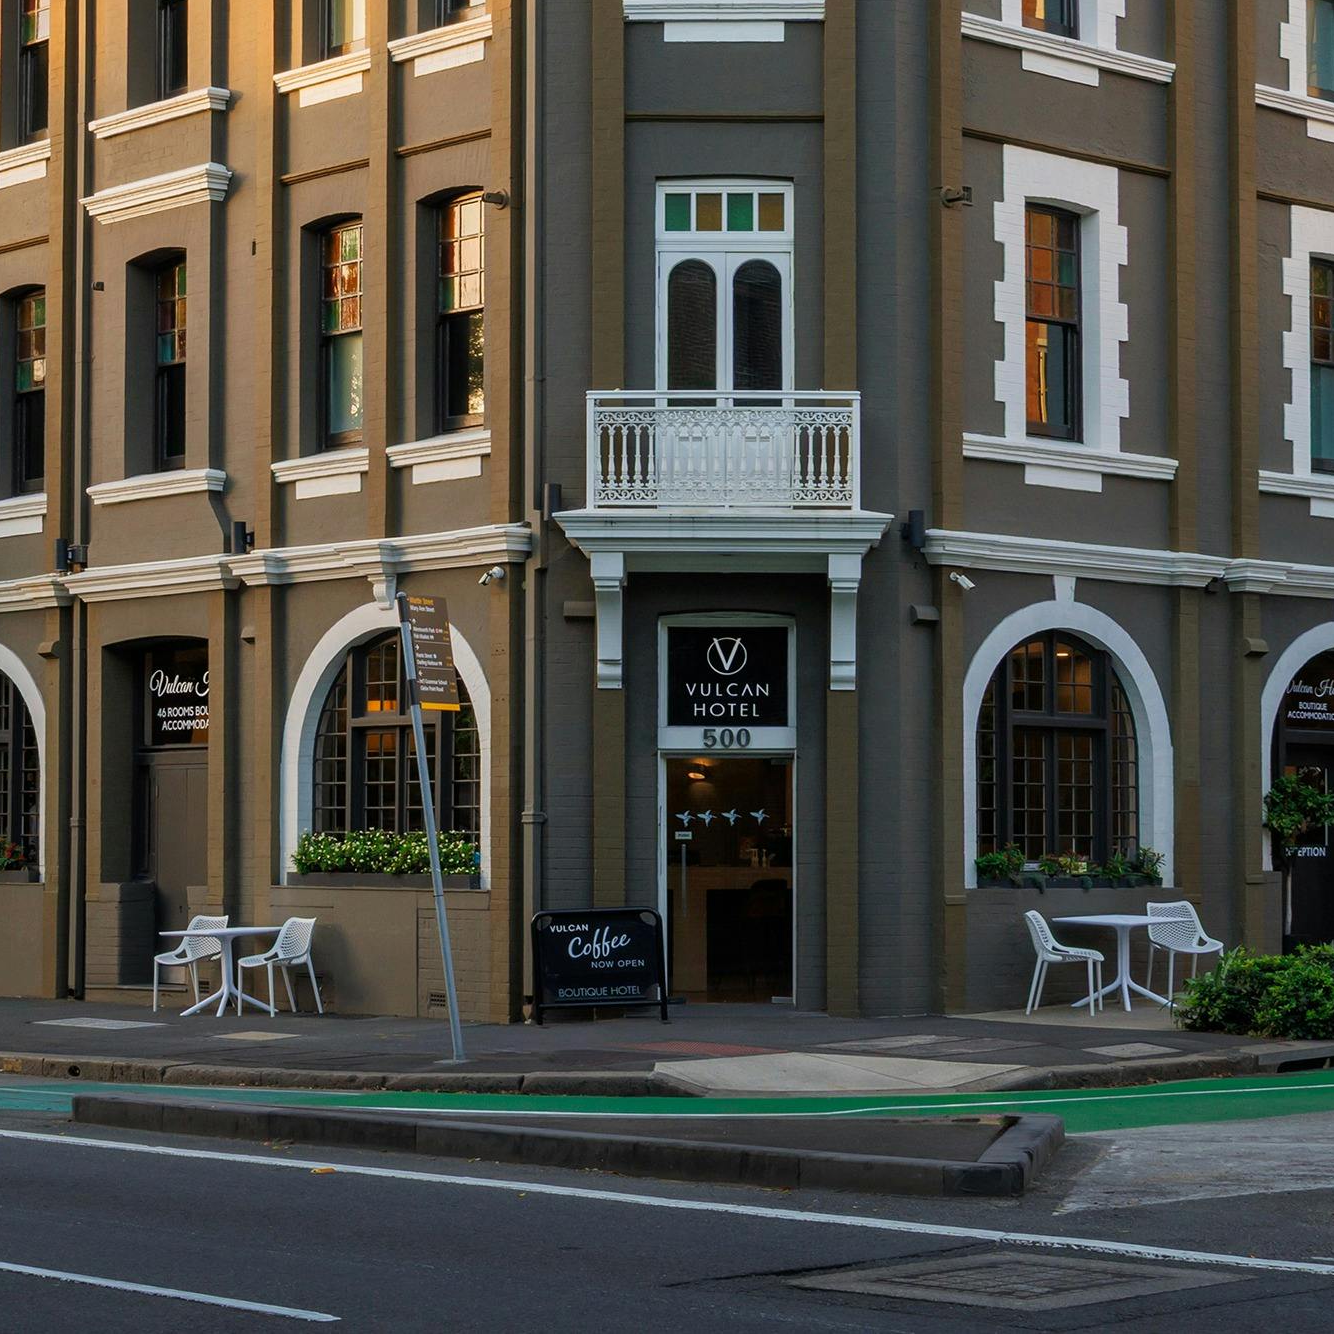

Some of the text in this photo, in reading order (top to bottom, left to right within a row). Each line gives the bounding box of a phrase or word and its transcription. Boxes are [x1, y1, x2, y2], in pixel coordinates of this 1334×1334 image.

[149, 669, 194, 697] Vulcan
[685, 683, 770, 697] VULCAN
[157, 707, 167, 718] 46
[167, 706, 194, 717] ROOMS
[693, 703, 760, 717] HOTEL
[1298, 701, 1328, 711] BOUTIQUE
[703, 728, 751, 748] 500
[1285, 847, 1326, 857] EPTION
[549, 923, 589, 933] VULCAN
[567, 926, 631, 959] Coffee
[591, 959, 645, 969] NOW OPEN
[558, 985, 641, 998] BOUTIQUE HOTEL
